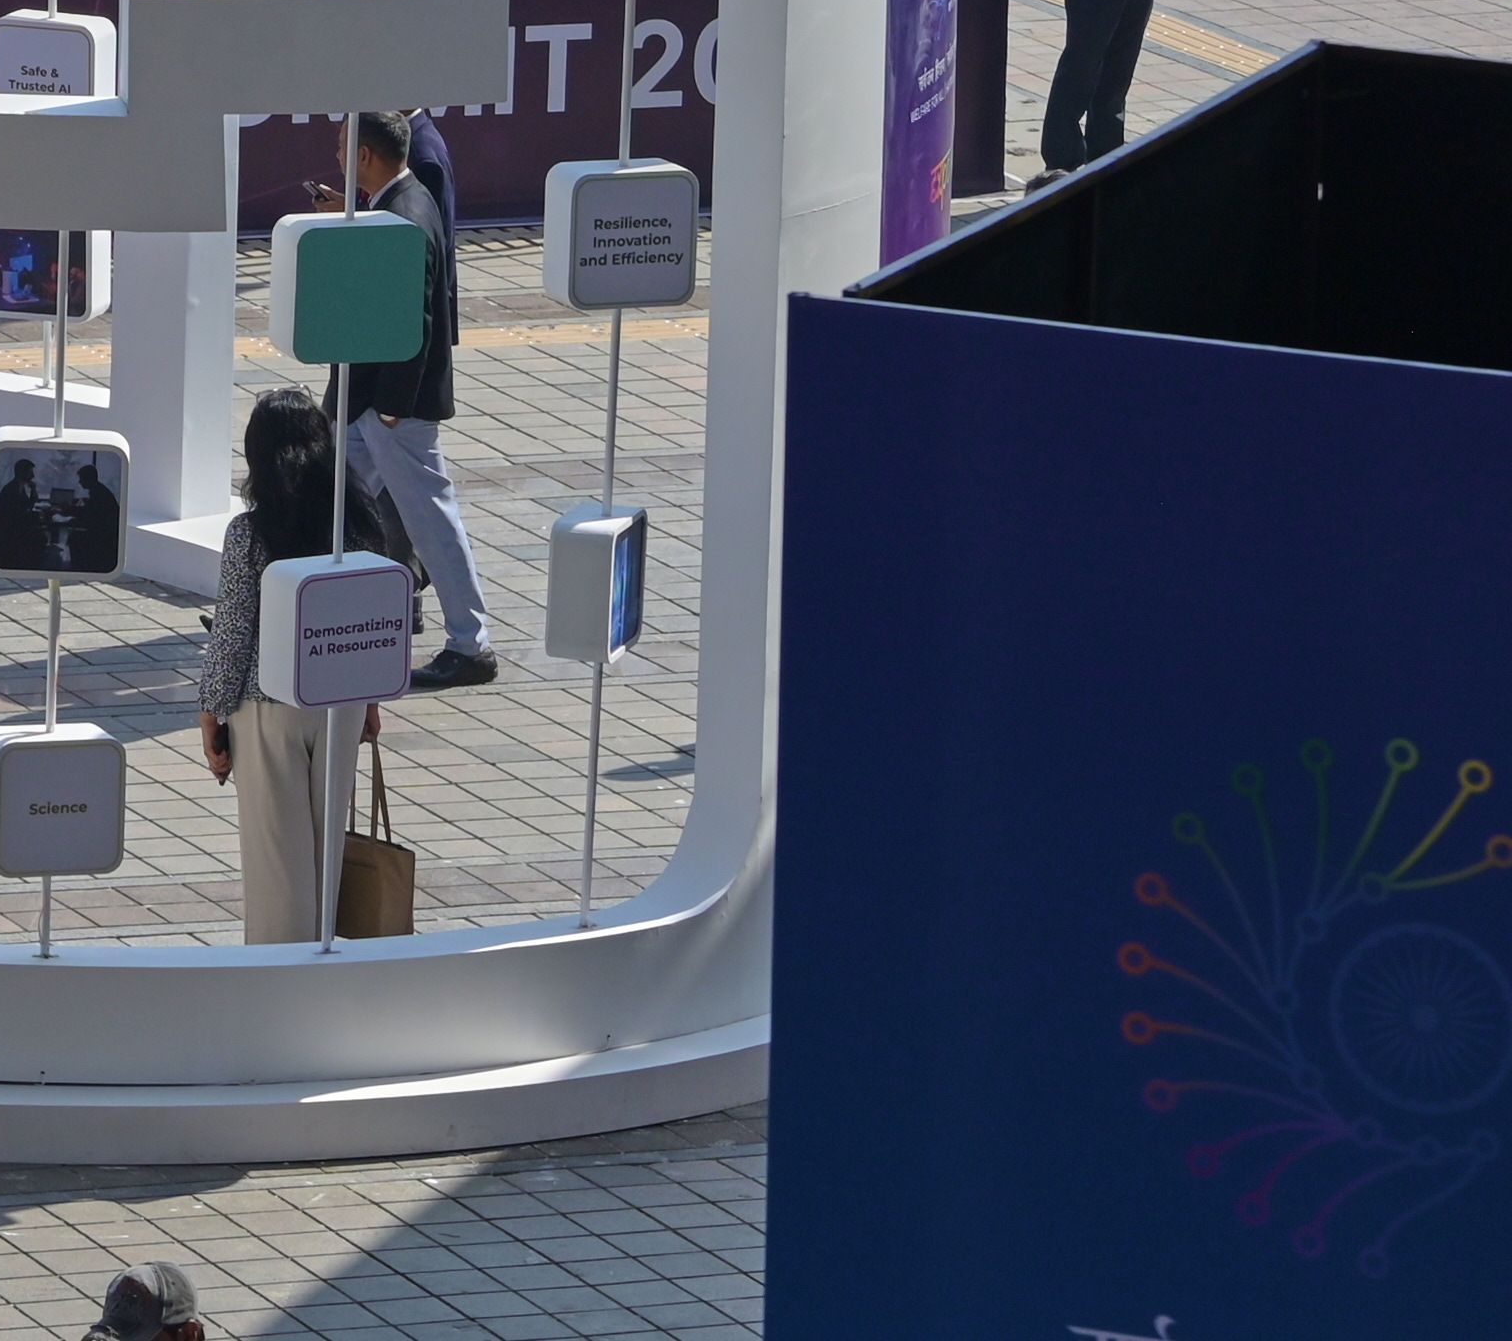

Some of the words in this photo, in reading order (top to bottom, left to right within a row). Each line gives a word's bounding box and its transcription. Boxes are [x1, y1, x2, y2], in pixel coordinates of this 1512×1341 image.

[20, 65, 47, 78] Safe
[50, 68, 59, 78] &
[8, 79, 55, 93] Trusted
[58, 84, 71, 94] AI
[593, 216, 673, 234] Resilience,
[592, 231, 672, 249] Innovation
[579, 252, 607, 267] and
[611, 248, 685, 268] Efficiency
[303, 615, 404, 642] Democratizing
[308, 643, 325, 658] AI
[326, 633, 398, 656] Resources
[28, 800, 89, 817] Science
